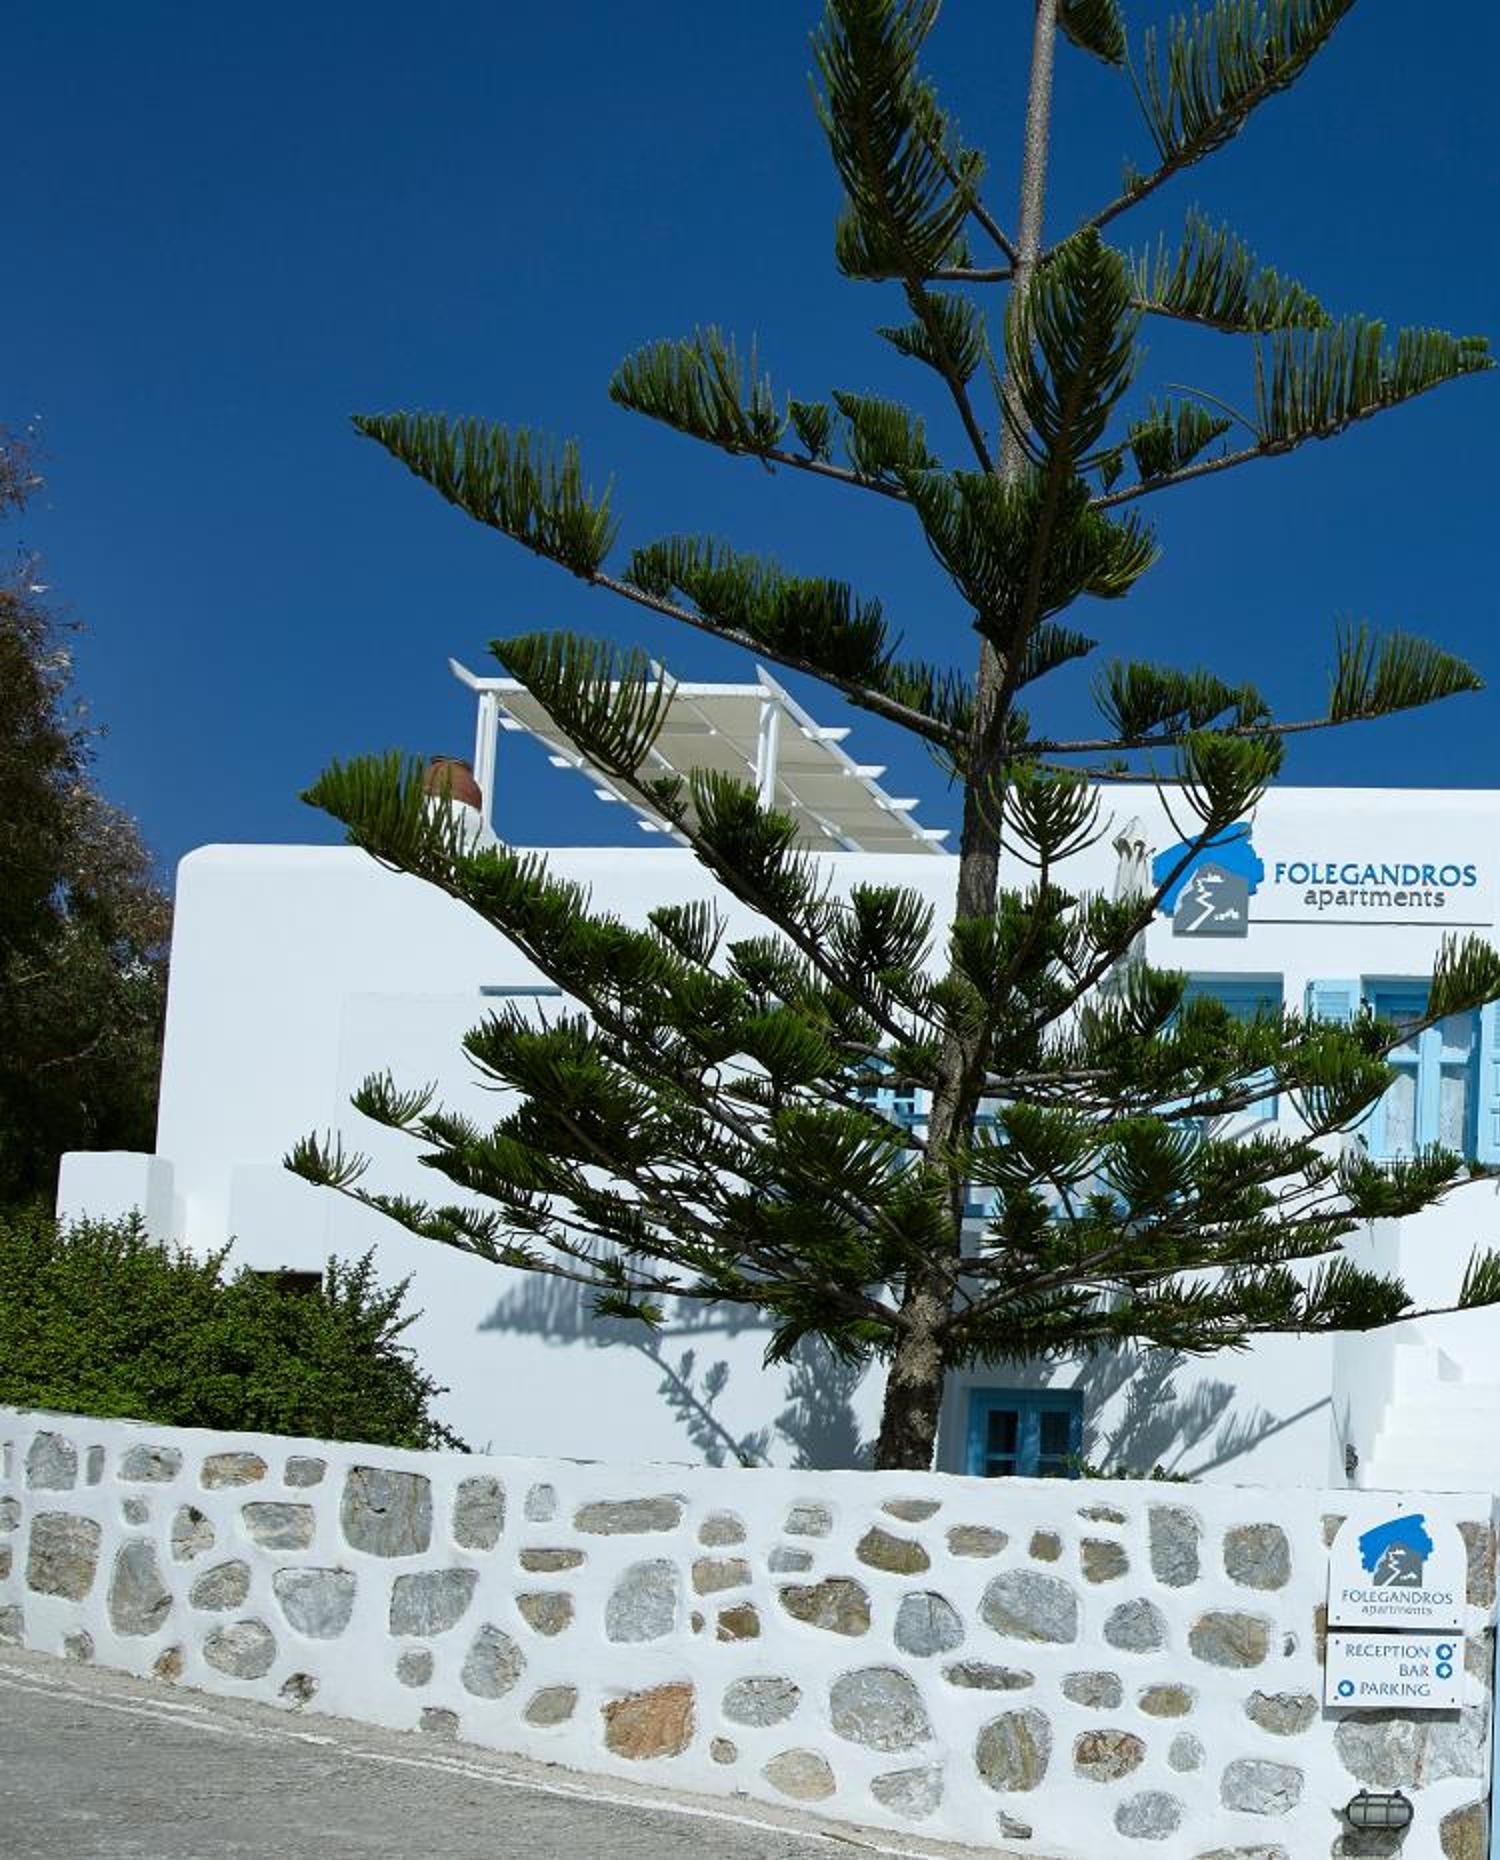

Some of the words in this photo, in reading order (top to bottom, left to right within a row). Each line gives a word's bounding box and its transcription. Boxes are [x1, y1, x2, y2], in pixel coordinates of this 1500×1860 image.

[1275, 863, 1477, 887] FOLEGANDROS
[1304, 887, 1446, 910] apartments
[1343, 1590, 1453, 1605] FOLEGANDROS
[1361, 1605, 1433, 1616] apartments
[1345, 1643, 1430, 1658] RECEPTION
[1399, 1663, 1430, 1677] BAR
[1360, 1682, 1431, 1696] PARKING
